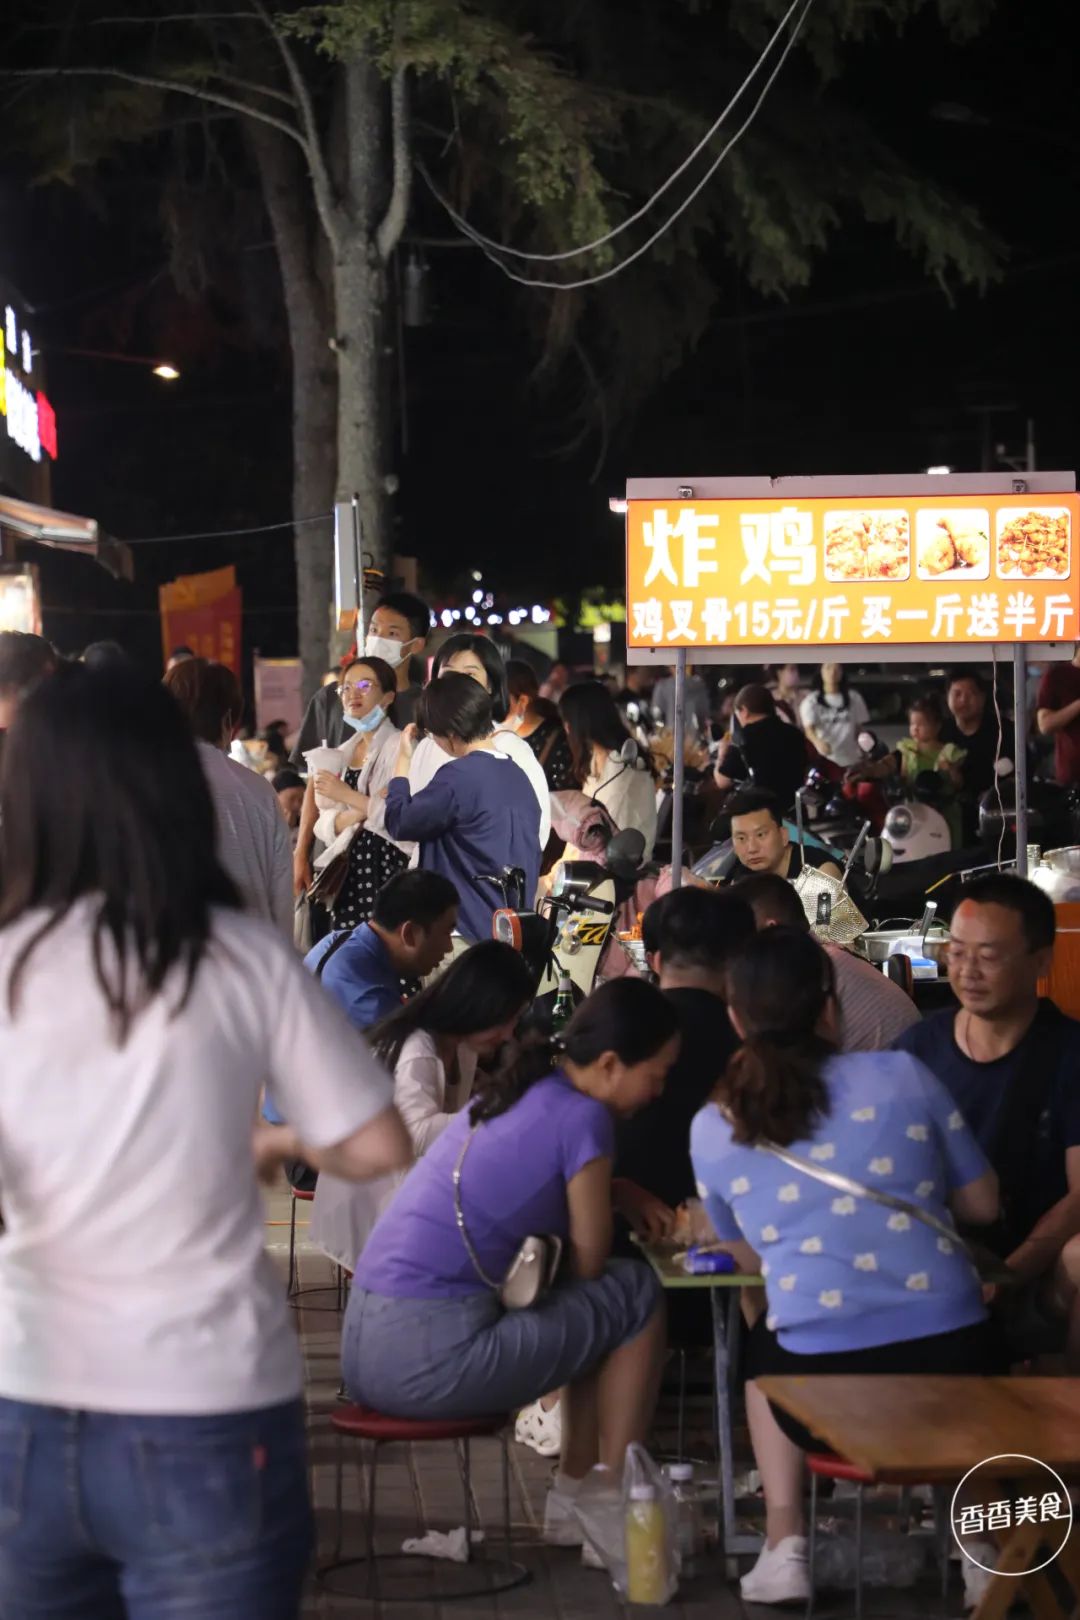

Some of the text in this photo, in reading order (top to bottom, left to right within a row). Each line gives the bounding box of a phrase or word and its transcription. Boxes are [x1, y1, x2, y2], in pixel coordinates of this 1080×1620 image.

[642, 507, 817, 588] 炸鸡
[860, 592, 1074, 639] 买一斤送半斤
